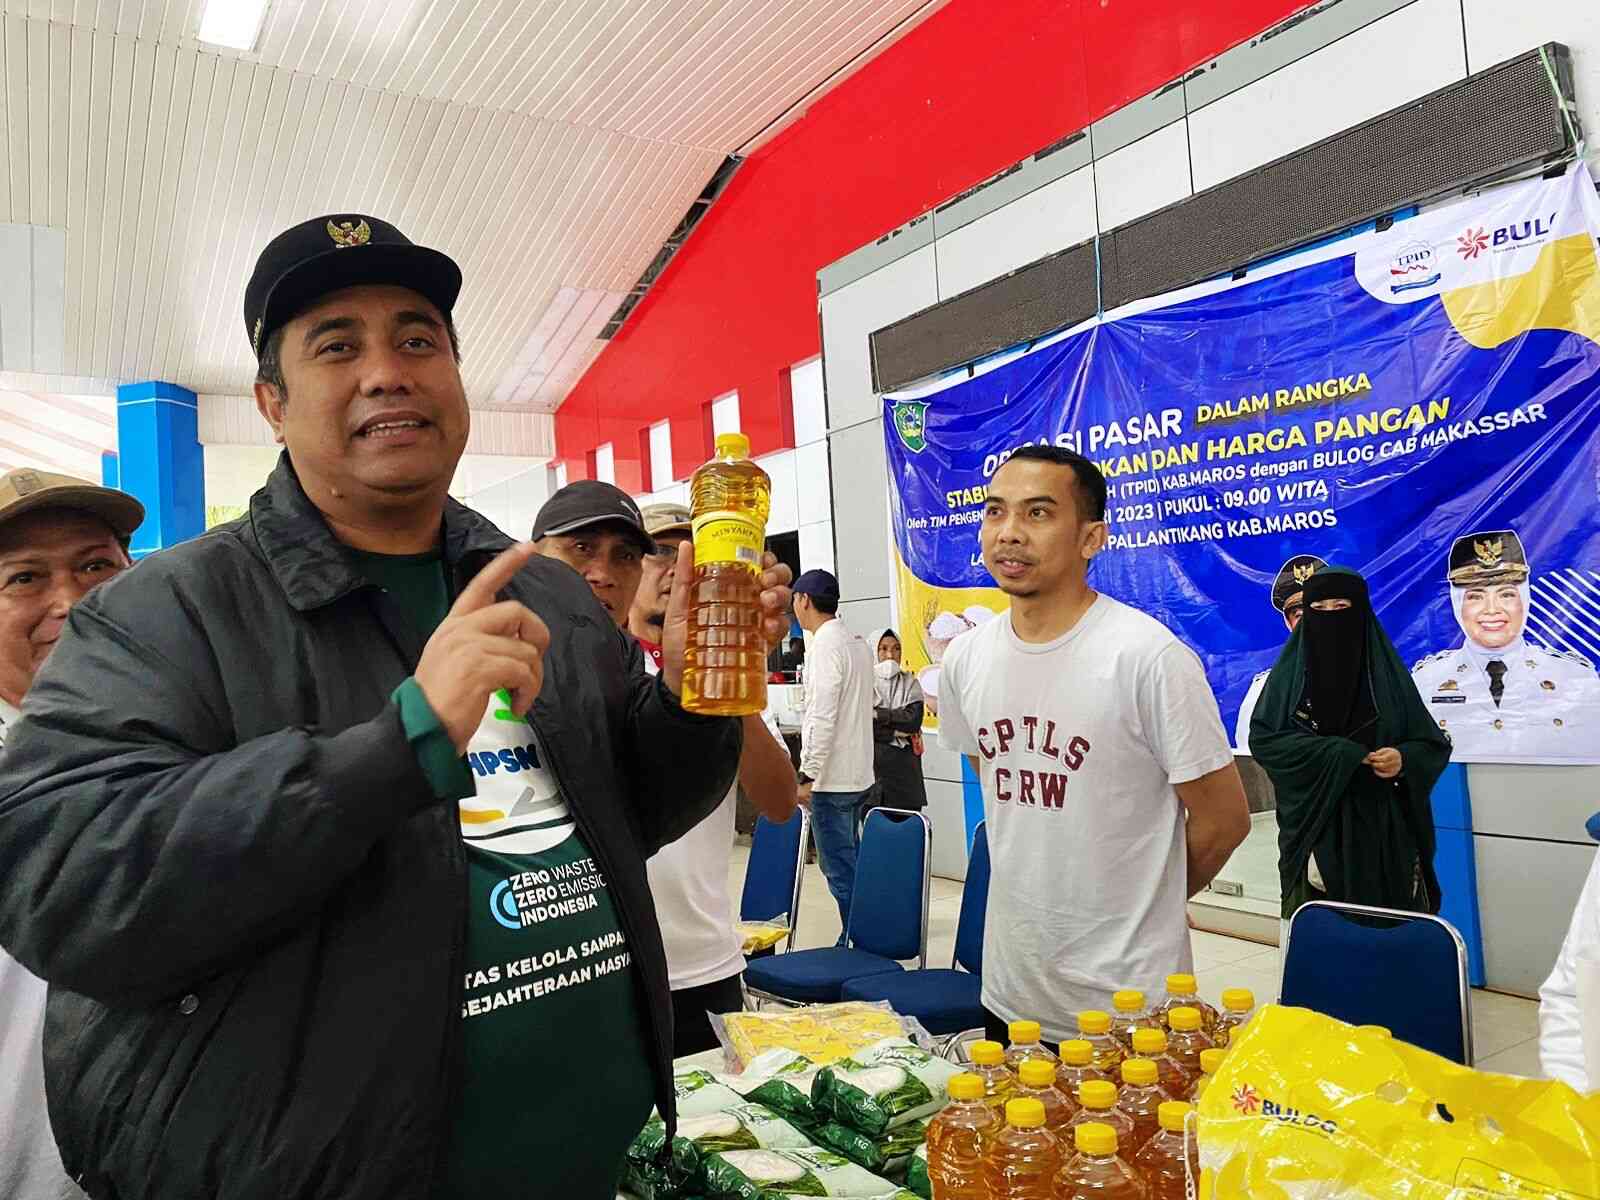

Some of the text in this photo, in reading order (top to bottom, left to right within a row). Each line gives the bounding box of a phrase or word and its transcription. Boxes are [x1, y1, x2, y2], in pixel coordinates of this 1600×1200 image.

[1493, 212, 1557, 246] BUL
[1089, 409, 1183, 452] PASAR
[1197, 389, 1270, 424] DALAM
[1276, 373, 1371, 408] RANGKA
[906, 517, 928, 529] Oleh
[930, 514, 947, 528] TIM
[948, 509, 985, 527] PENGEN
[1120, 477, 1160, 500] (TPID)
[1162, 464, 1246, 491] KAB.MAROS
[1250, 456, 1308, 478] dengan
[1313, 445, 1374, 469] BULOG
[1379, 435, 1418, 459] CAB
[1421, 402, 1547, 450] MAKASSAR
[946, 485, 989, 508] STABI
[1152, 442, 1200, 470] DAN
[1206, 427, 1307, 461] HARGA
[1314, 398, 1451, 443] PANGAN
[1115, 503, 1154, 523] 2023
[1164, 495, 1213, 517] PUKUL
[1223, 486, 1271, 508] 09.00
[1276, 479, 1329, 502] WITA
[1107, 522, 1223, 551] PALLANTIKANG
[1227, 508, 1337, 539] KAB.MAROS
[977, 716, 1091, 771] CPTLS
[995, 767, 1068, 809] CRW
[509, 857, 597, 891] ZERO WASTE
[515, 885, 558, 908] ZERO
[520, 893, 599, 927] INDONESIA
[506, 946, 578, 978] KELOLA
[581, 930, 626, 957] SAMPA
[594, 951, 632, 978] MASYA
[1262, 1098, 1338, 1135] BULOG
